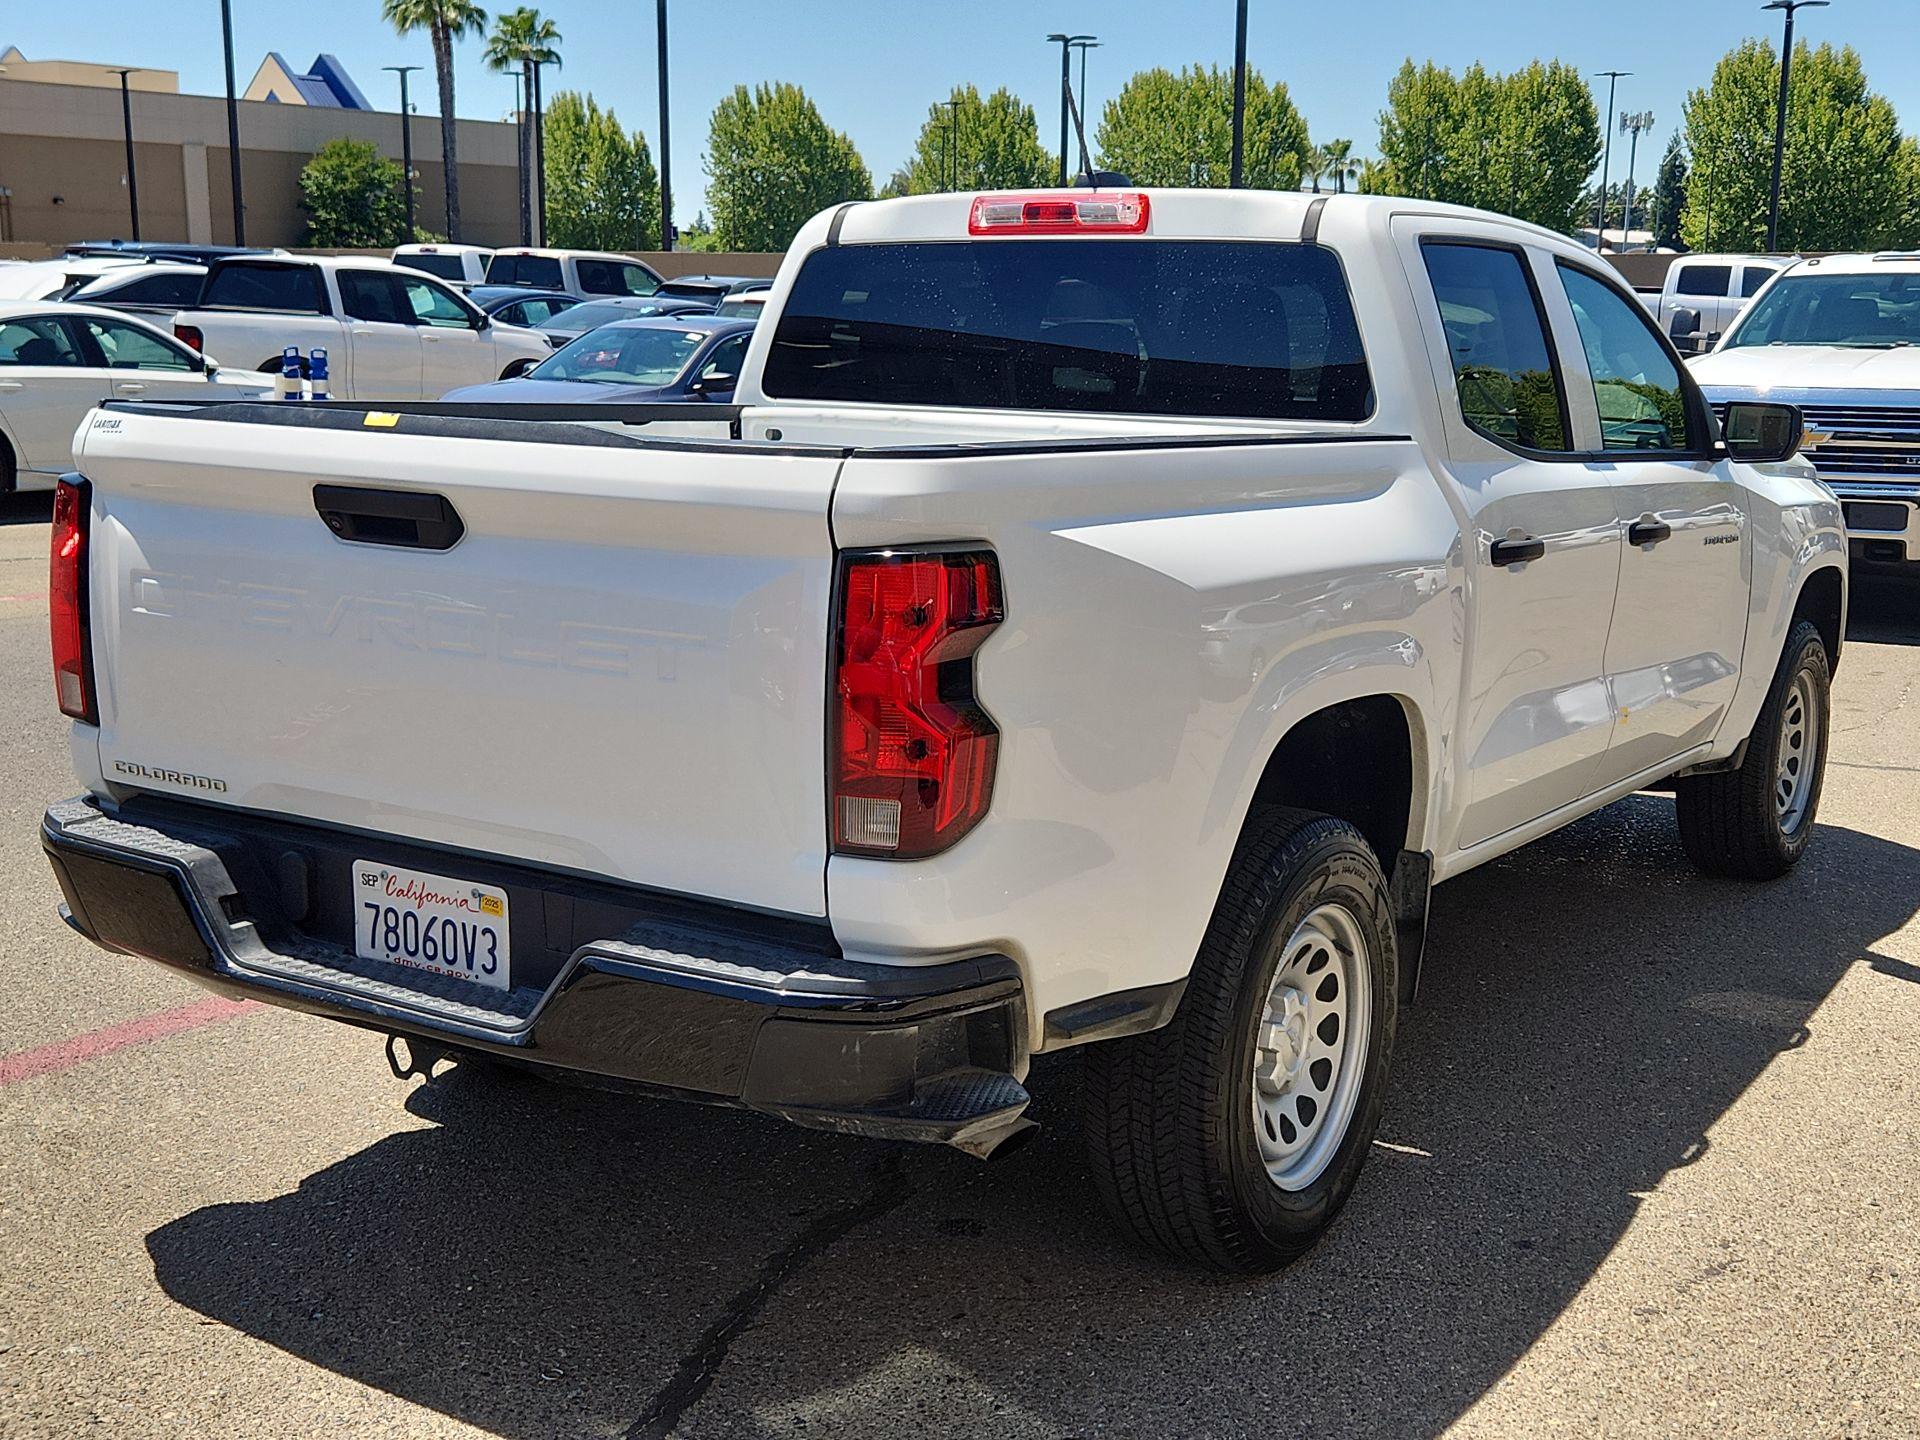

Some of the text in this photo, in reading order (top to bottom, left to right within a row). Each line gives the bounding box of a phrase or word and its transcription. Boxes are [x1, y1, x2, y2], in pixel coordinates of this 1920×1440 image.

[131, 567, 707, 681] CHEVROLET
[114, 760, 227, 792] COLORADO
[361, 873, 379, 887] SEP
[385, 875, 480, 913] California
[364, 902, 497, 975] 78060V3
[393, 957, 471, 979] dmv.ca.gov
